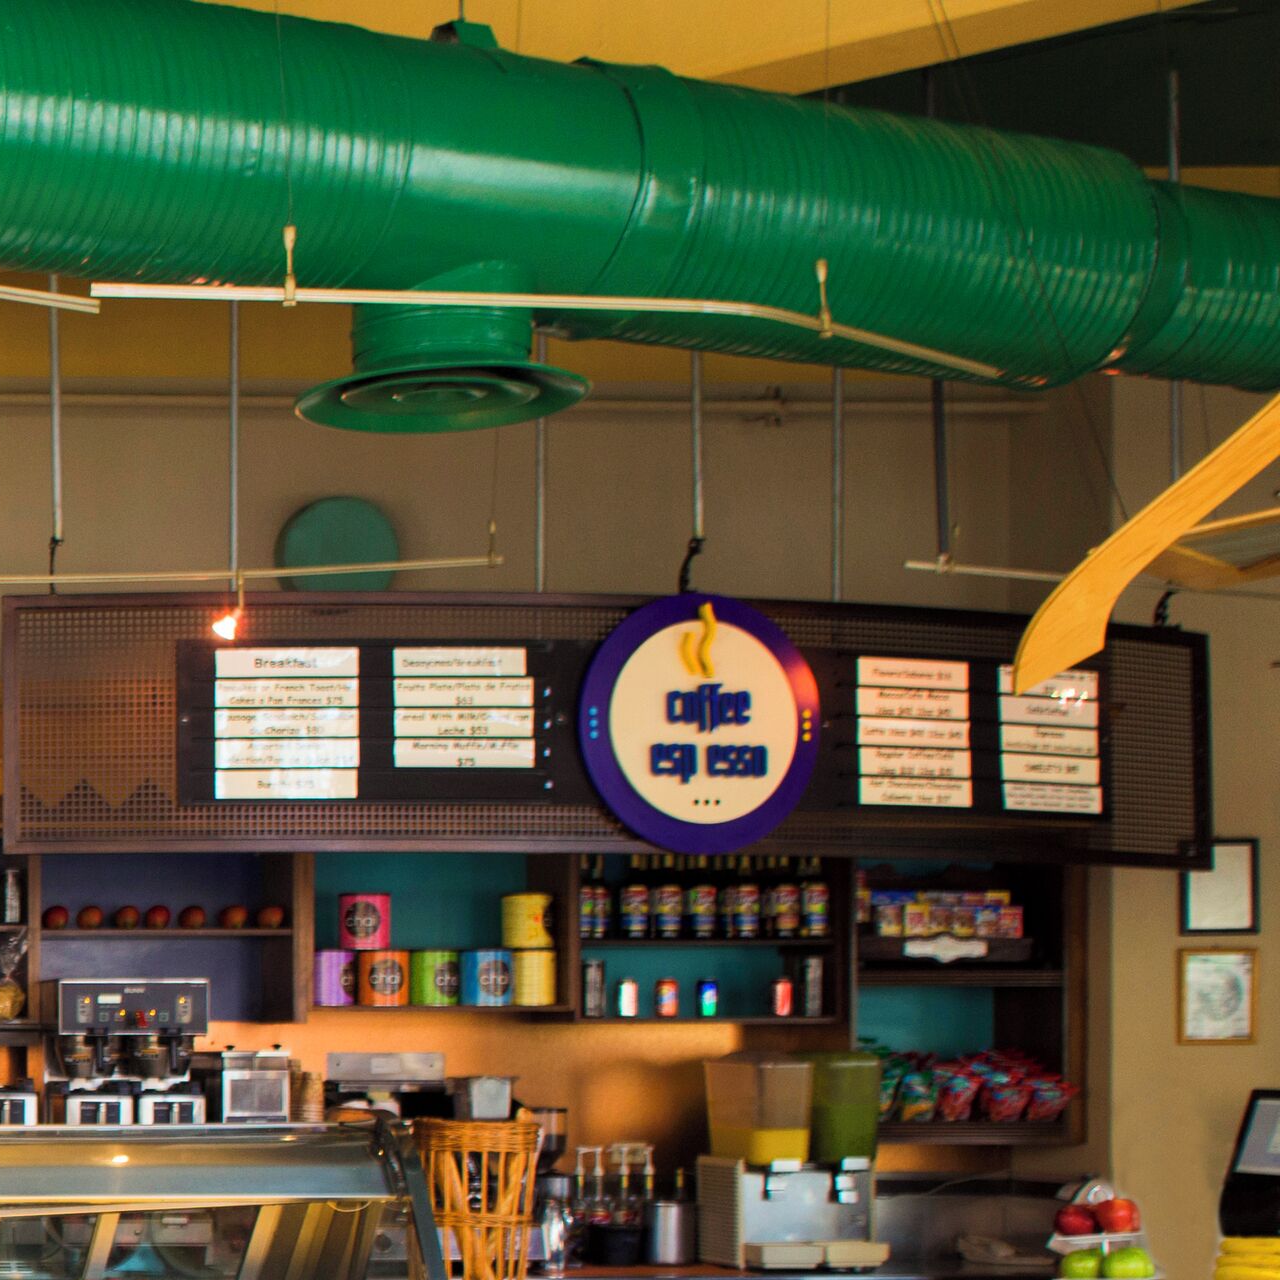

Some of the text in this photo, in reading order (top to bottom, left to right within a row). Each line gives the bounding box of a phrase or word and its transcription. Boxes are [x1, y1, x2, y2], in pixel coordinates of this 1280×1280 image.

[254, 658, 318, 669] Breakfast
[666, 683, 752, 733] coffee
[369, 973, 401, 987] chai
